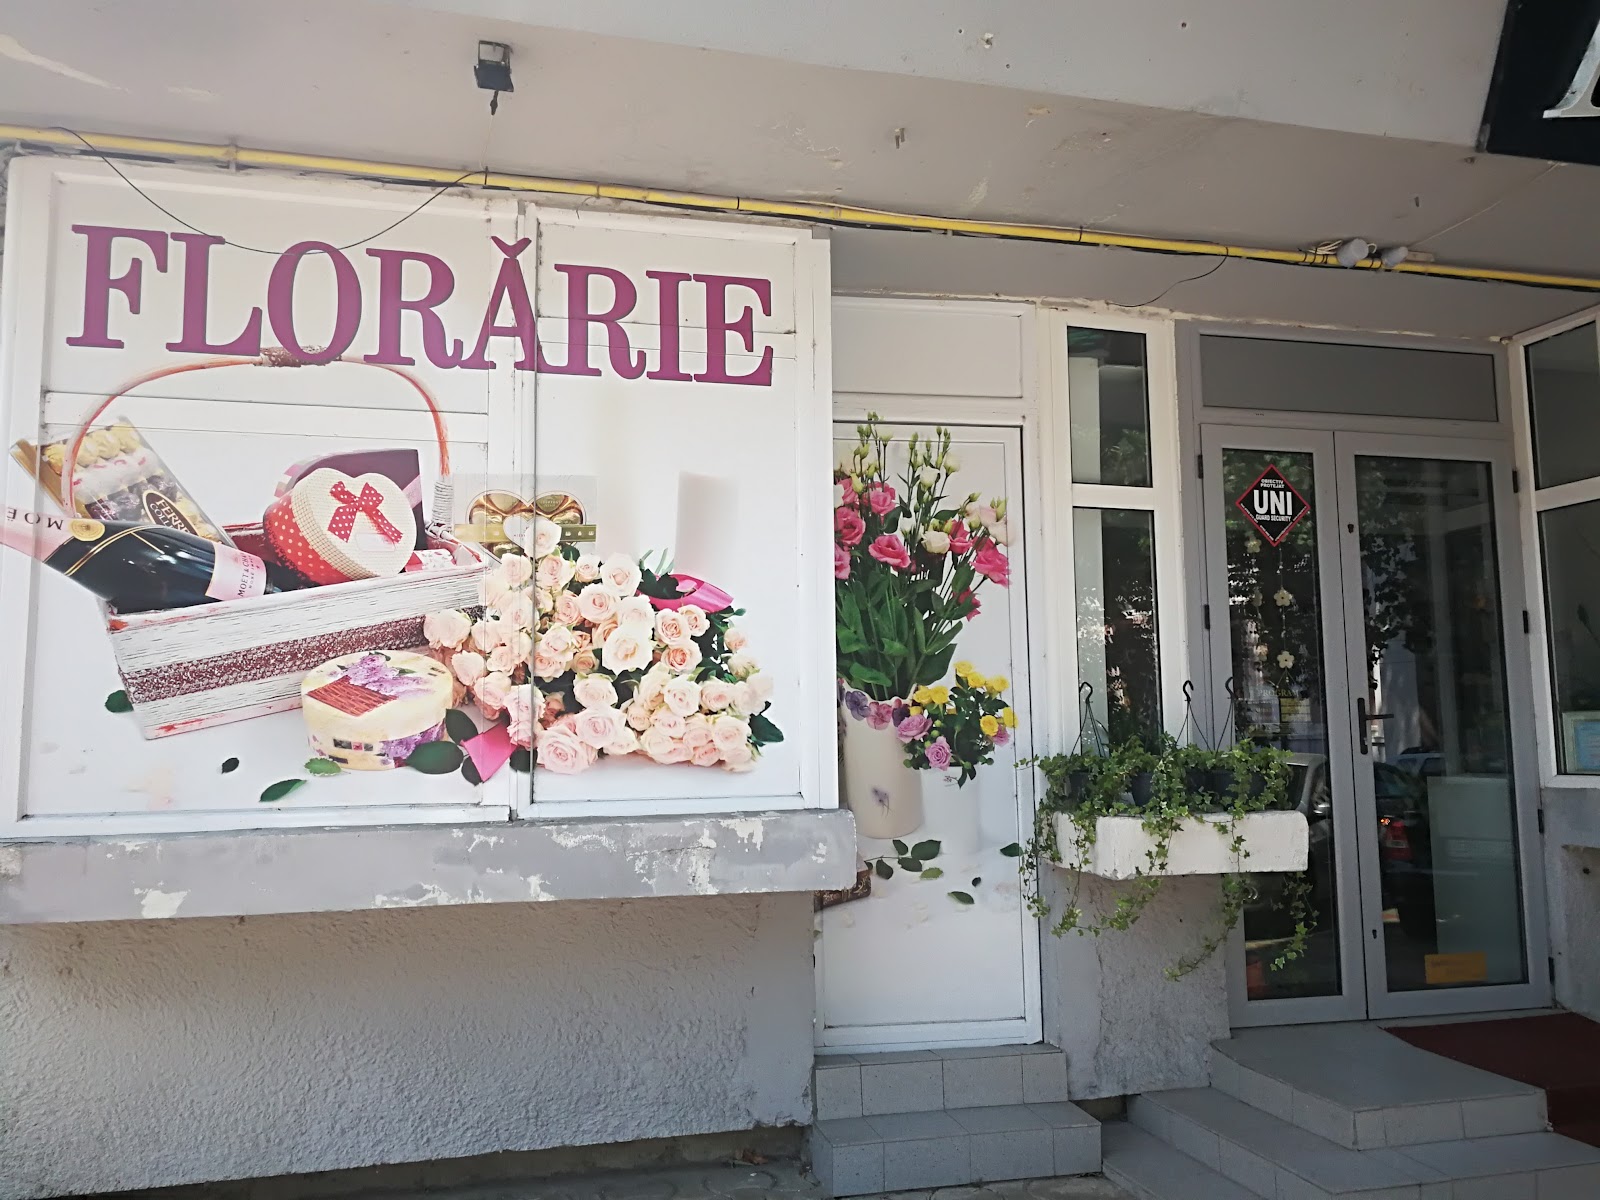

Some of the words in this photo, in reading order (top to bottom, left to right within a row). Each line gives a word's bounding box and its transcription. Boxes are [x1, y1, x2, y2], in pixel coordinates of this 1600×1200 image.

[66, 224, 773, 388] FLORĂRIE
[1253, 489, 1293, 516] UNI
[1257, 688, 1299, 697] PROGRAM
